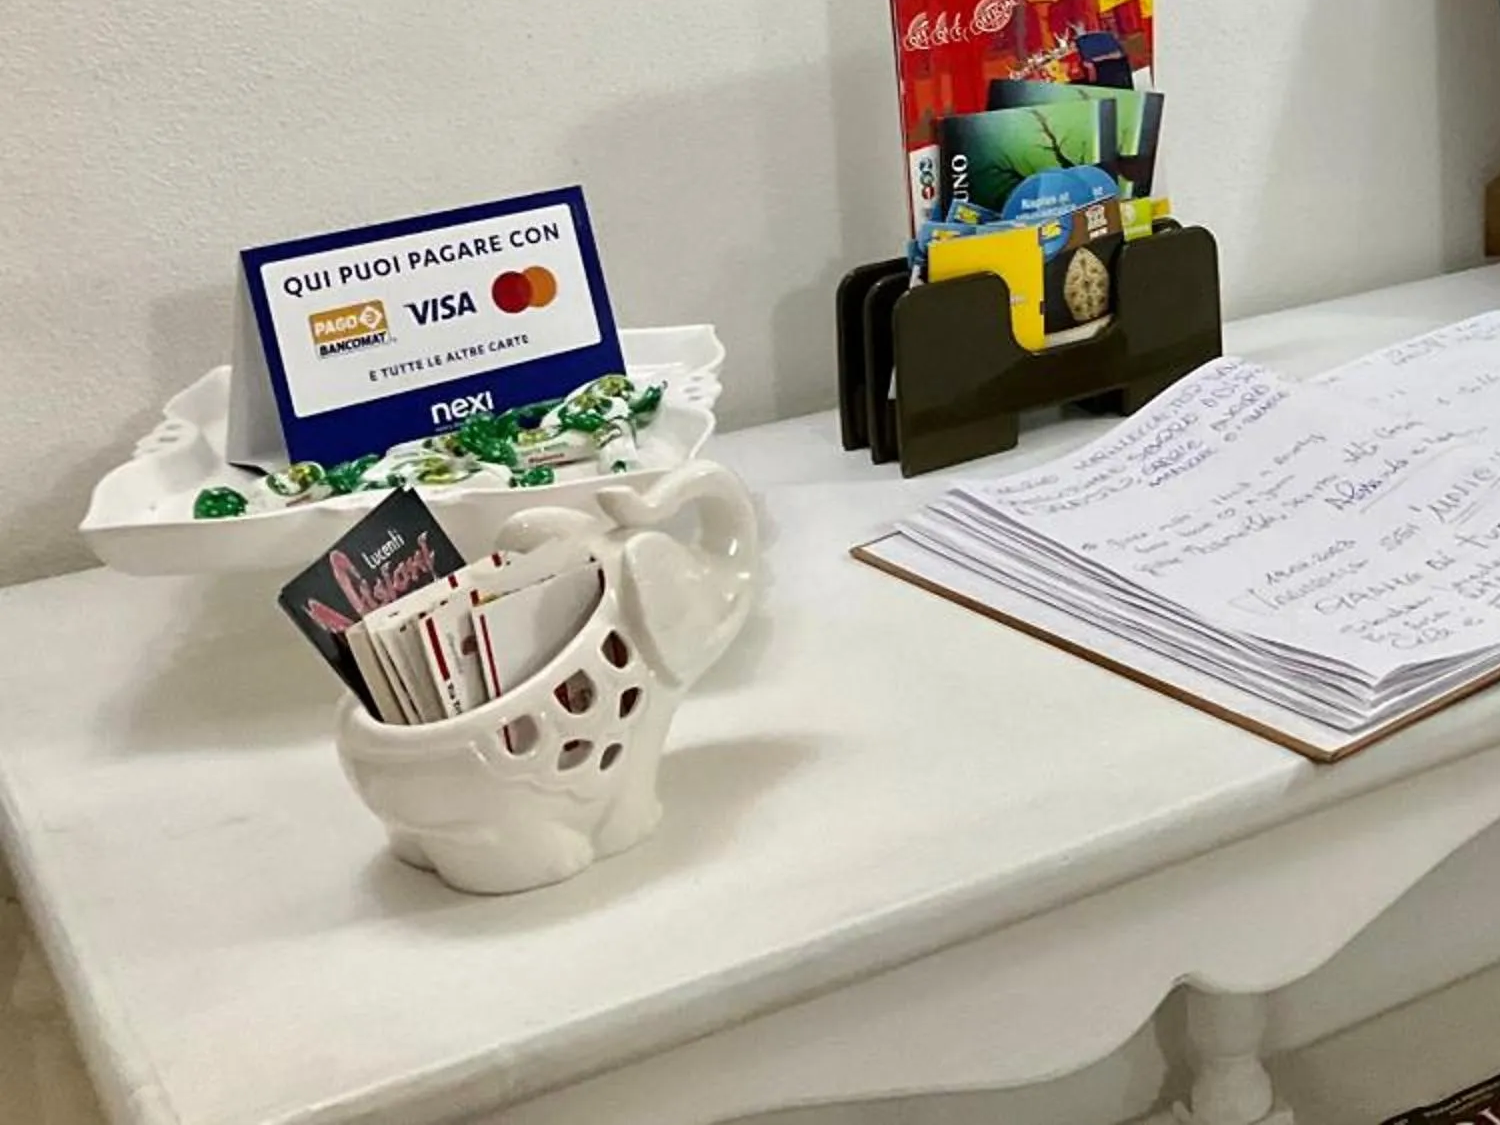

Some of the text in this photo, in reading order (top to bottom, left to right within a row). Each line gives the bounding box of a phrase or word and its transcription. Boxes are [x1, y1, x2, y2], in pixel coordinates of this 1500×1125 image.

[283, 222, 561, 298] QUI PUOI PAGARE CON
[404, 291, 478, 326] VISA
[314, 315, 358, 337] PAGO
[320, 331, 387, 356] BANCOMAT
[381, 359, 425, 380] TUTTE
[426, 354, 443, 368] LE
[446, 343, 486, 365] ALTRE
[488, 333, 530, 354] CARTE
[431, 391, 496, 424] nexi
